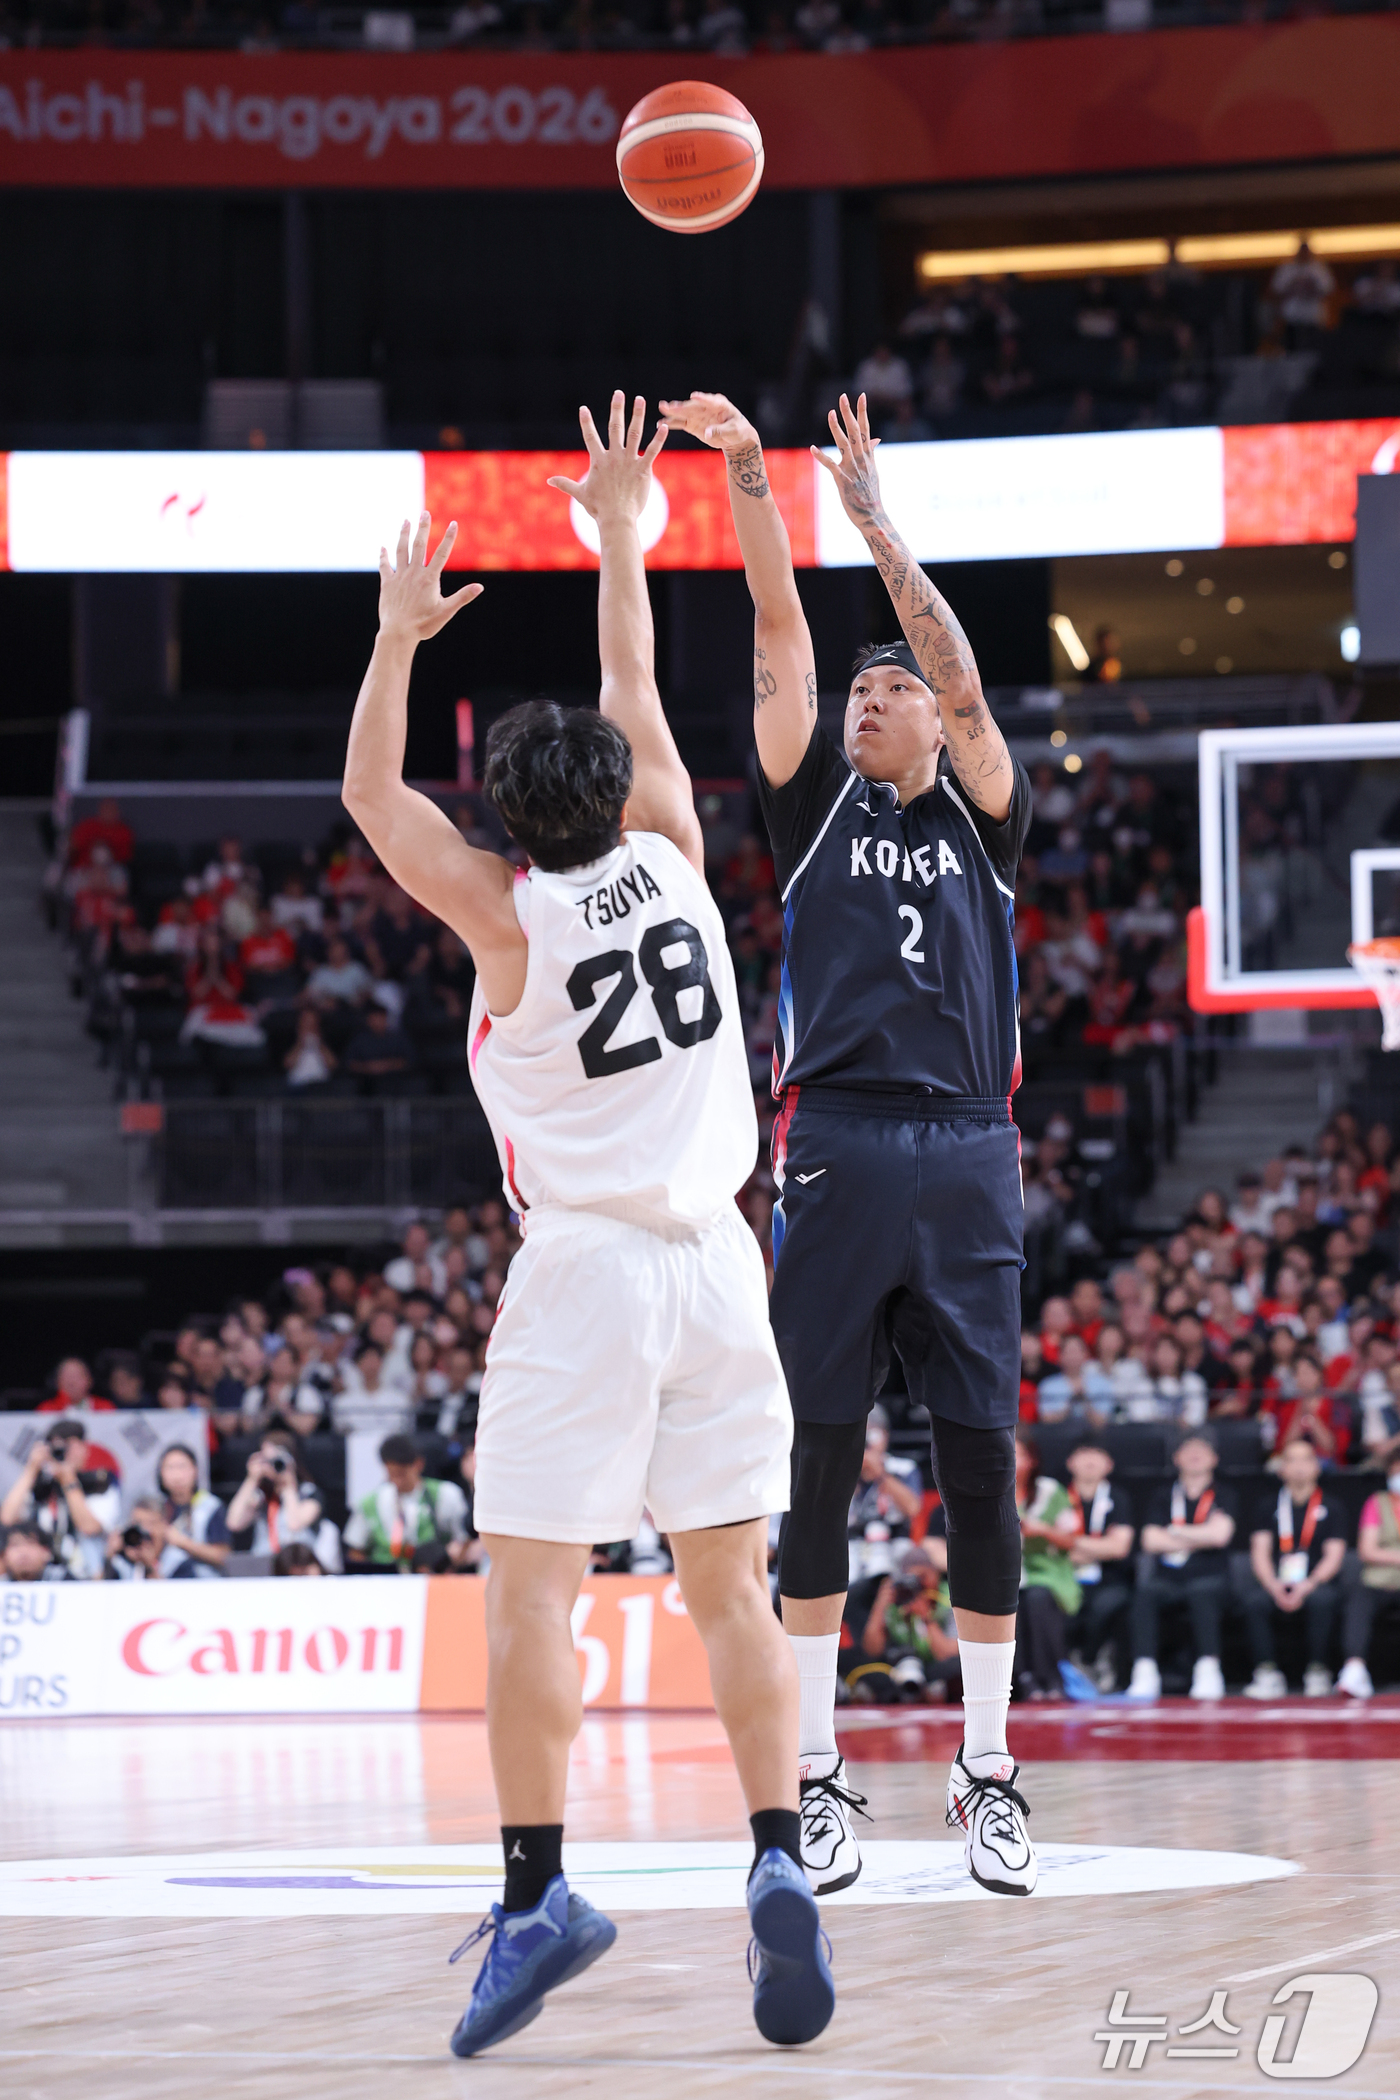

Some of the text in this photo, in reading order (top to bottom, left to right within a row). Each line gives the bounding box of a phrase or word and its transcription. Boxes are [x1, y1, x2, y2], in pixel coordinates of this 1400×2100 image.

[452, 84, 618, 144] 2026
[656, 188, 722, 210] molten
[576, 864, 662, 930] TSUYA
[898, 904, 925, 963] 2
[566, 917, 723, 1079] 28
[121, 1617, 404, 1678] Canon
